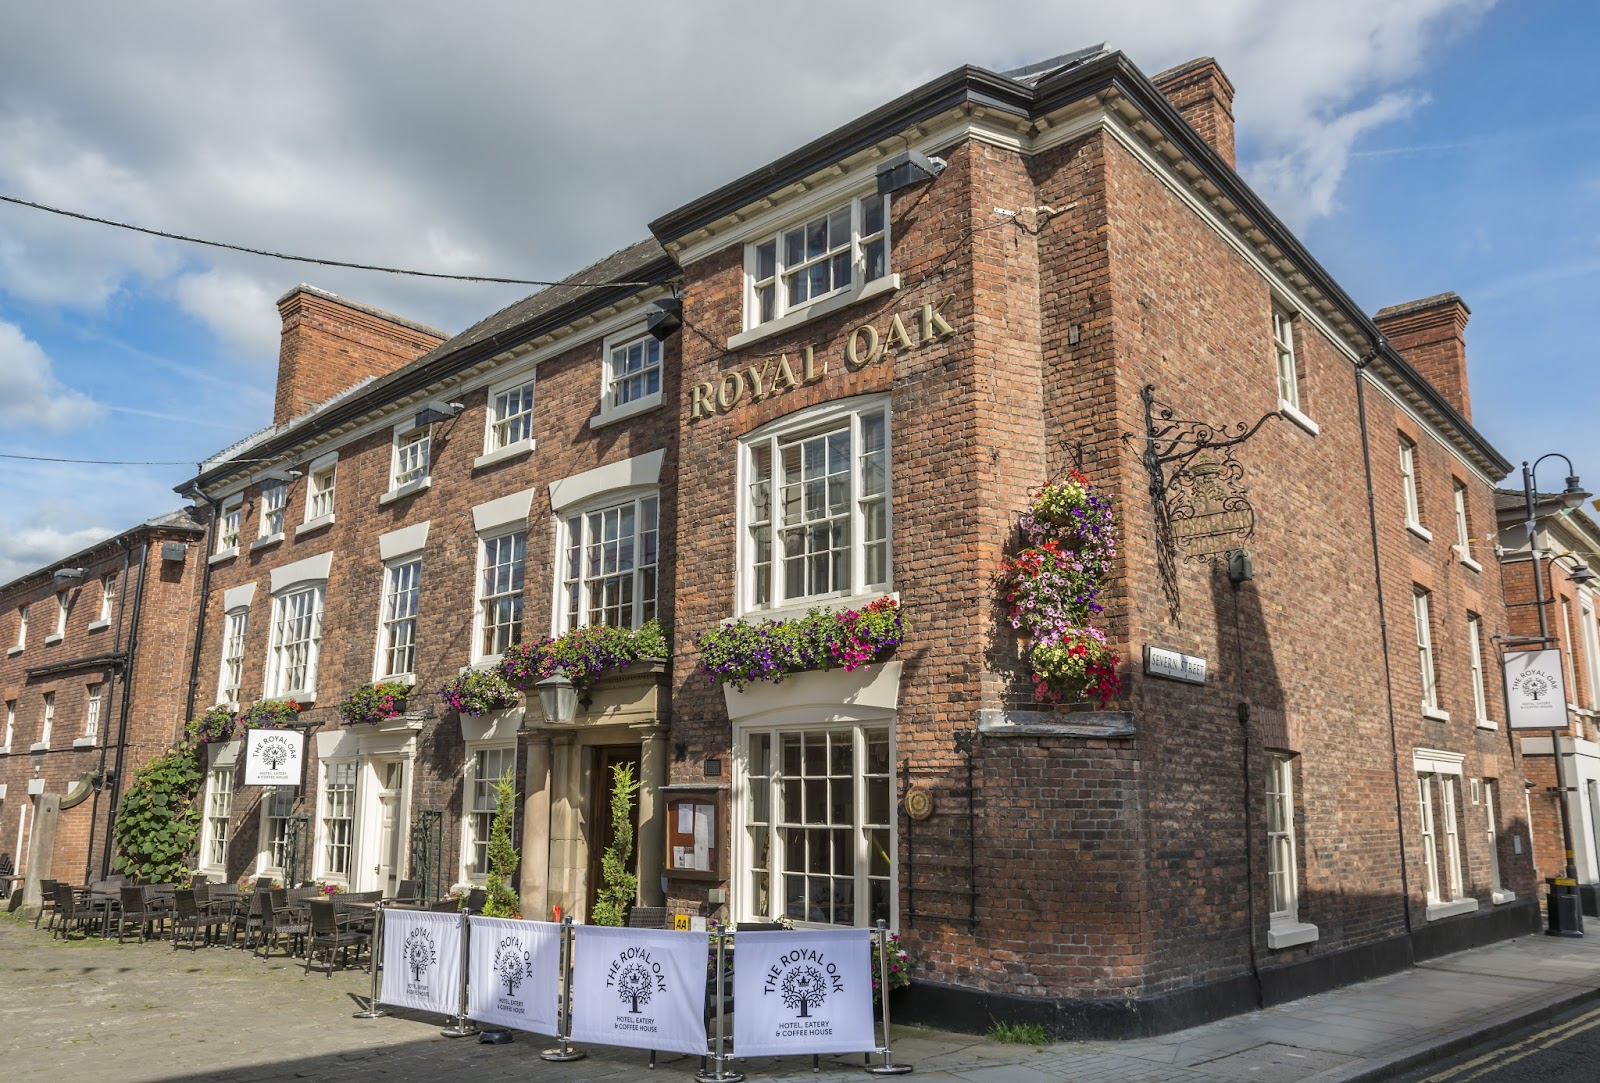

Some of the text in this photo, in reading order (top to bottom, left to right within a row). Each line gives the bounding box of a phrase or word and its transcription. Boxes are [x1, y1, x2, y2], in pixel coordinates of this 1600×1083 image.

[690, 293, 958, 421] ROYAL OAK
[1172, 508, 1251, 537] ROYAL OAK
[1152, 653, 1204, 676] SEVERN STREET
[1512, 669, 1558, 691] THE ROYAL OAK
[253, 736, 296, 759] THE ROYAL OAK
[676, 919, 686, 929] AA
[403, 938, 411, 960] THE
[411, 927, 430, 942] ROYAL
[493, 936, 532, 978] THE ROYAL OAK
[607, 947, 667, 992] THE ROYAL OAK
[764, 949, 844, 995] THE ROYAL OAK
[810, 1028, 833, 1036] HOUSE
